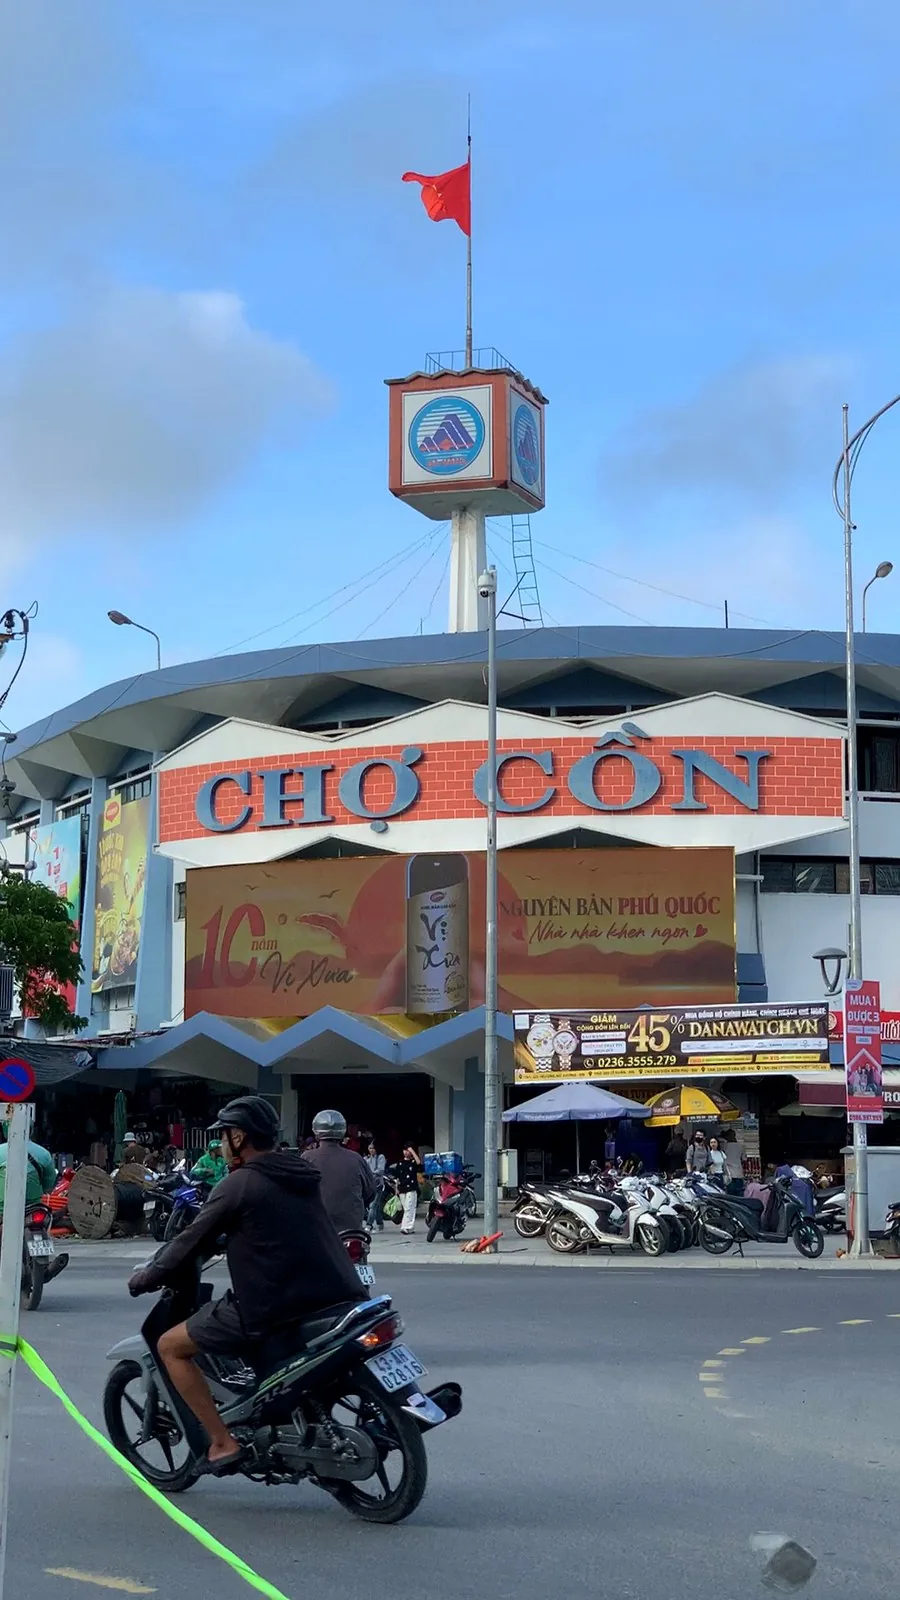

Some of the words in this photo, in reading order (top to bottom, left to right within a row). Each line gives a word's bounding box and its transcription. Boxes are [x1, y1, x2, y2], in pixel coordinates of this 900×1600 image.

[195, 745, 424, 834] CHỢ
[473, 721, 772, 813] CỒN
[576, 893, 613, 917] BẢN
[618, 893, 660, 916] PHÚ
[664, 892, 721, 918] QUỐC
[529, 920, 567, 944] Nhà
[570, 923, 603, 940] nhà
[606, 921, 646, 940] khen
[650, 929, 690, 945] ngon
[260, 951, 296, 994] Vị
[296, 957, 354, 994] Xưa
[850, 994, 871, 1006] MUA
[872, 996, 877, 1007] 1
[590, 1013, 617, 1024] GIẢM
[847, 1010, 873, 1024] ĐƯỢC
[873, 1011, 880, 1023] 3
[597, 1055, 677, 1068] 0236.3555.279
[374, 1347, 409, 1372] 43-AH
[381, 1361, 423, 1389] 028.16
